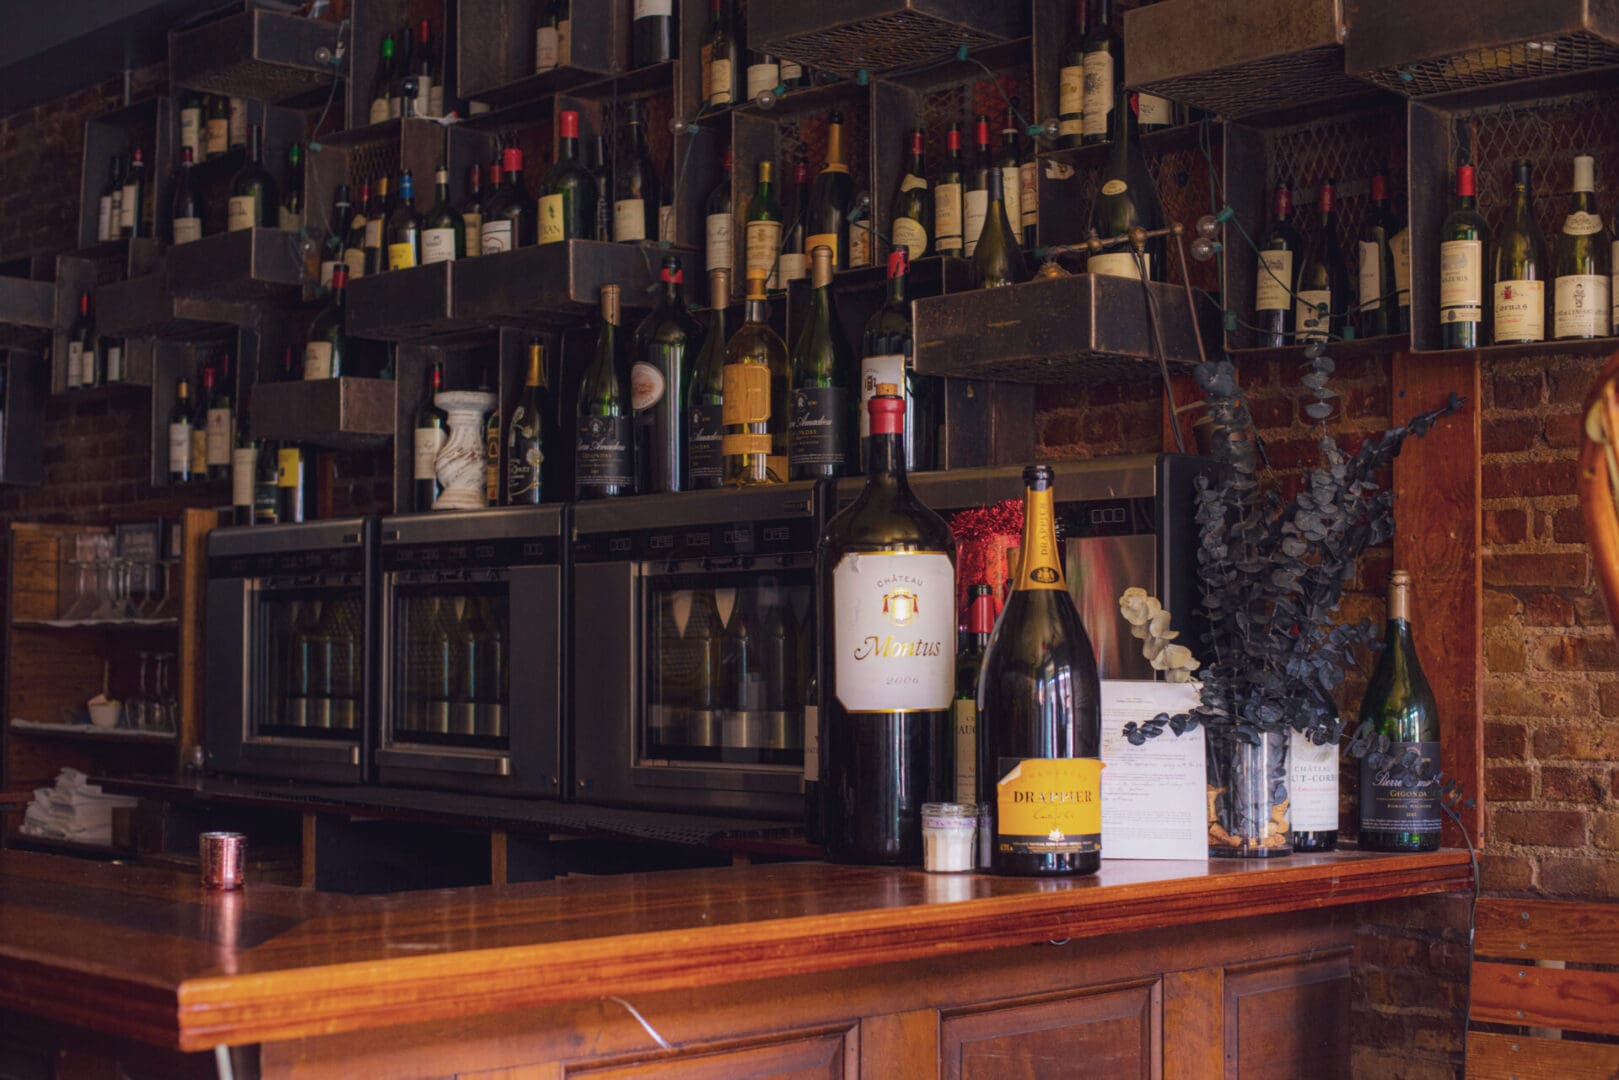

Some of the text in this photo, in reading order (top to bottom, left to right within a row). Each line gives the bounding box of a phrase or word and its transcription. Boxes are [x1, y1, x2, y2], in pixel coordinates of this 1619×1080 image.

[876, 573, 924, 589] CHÂTEAU
[853, 634, 942, 661] Montus
[1013, 790, 1092, 804] DRAPPIER
[1389, 789, 1429, 798] GIGONDA
